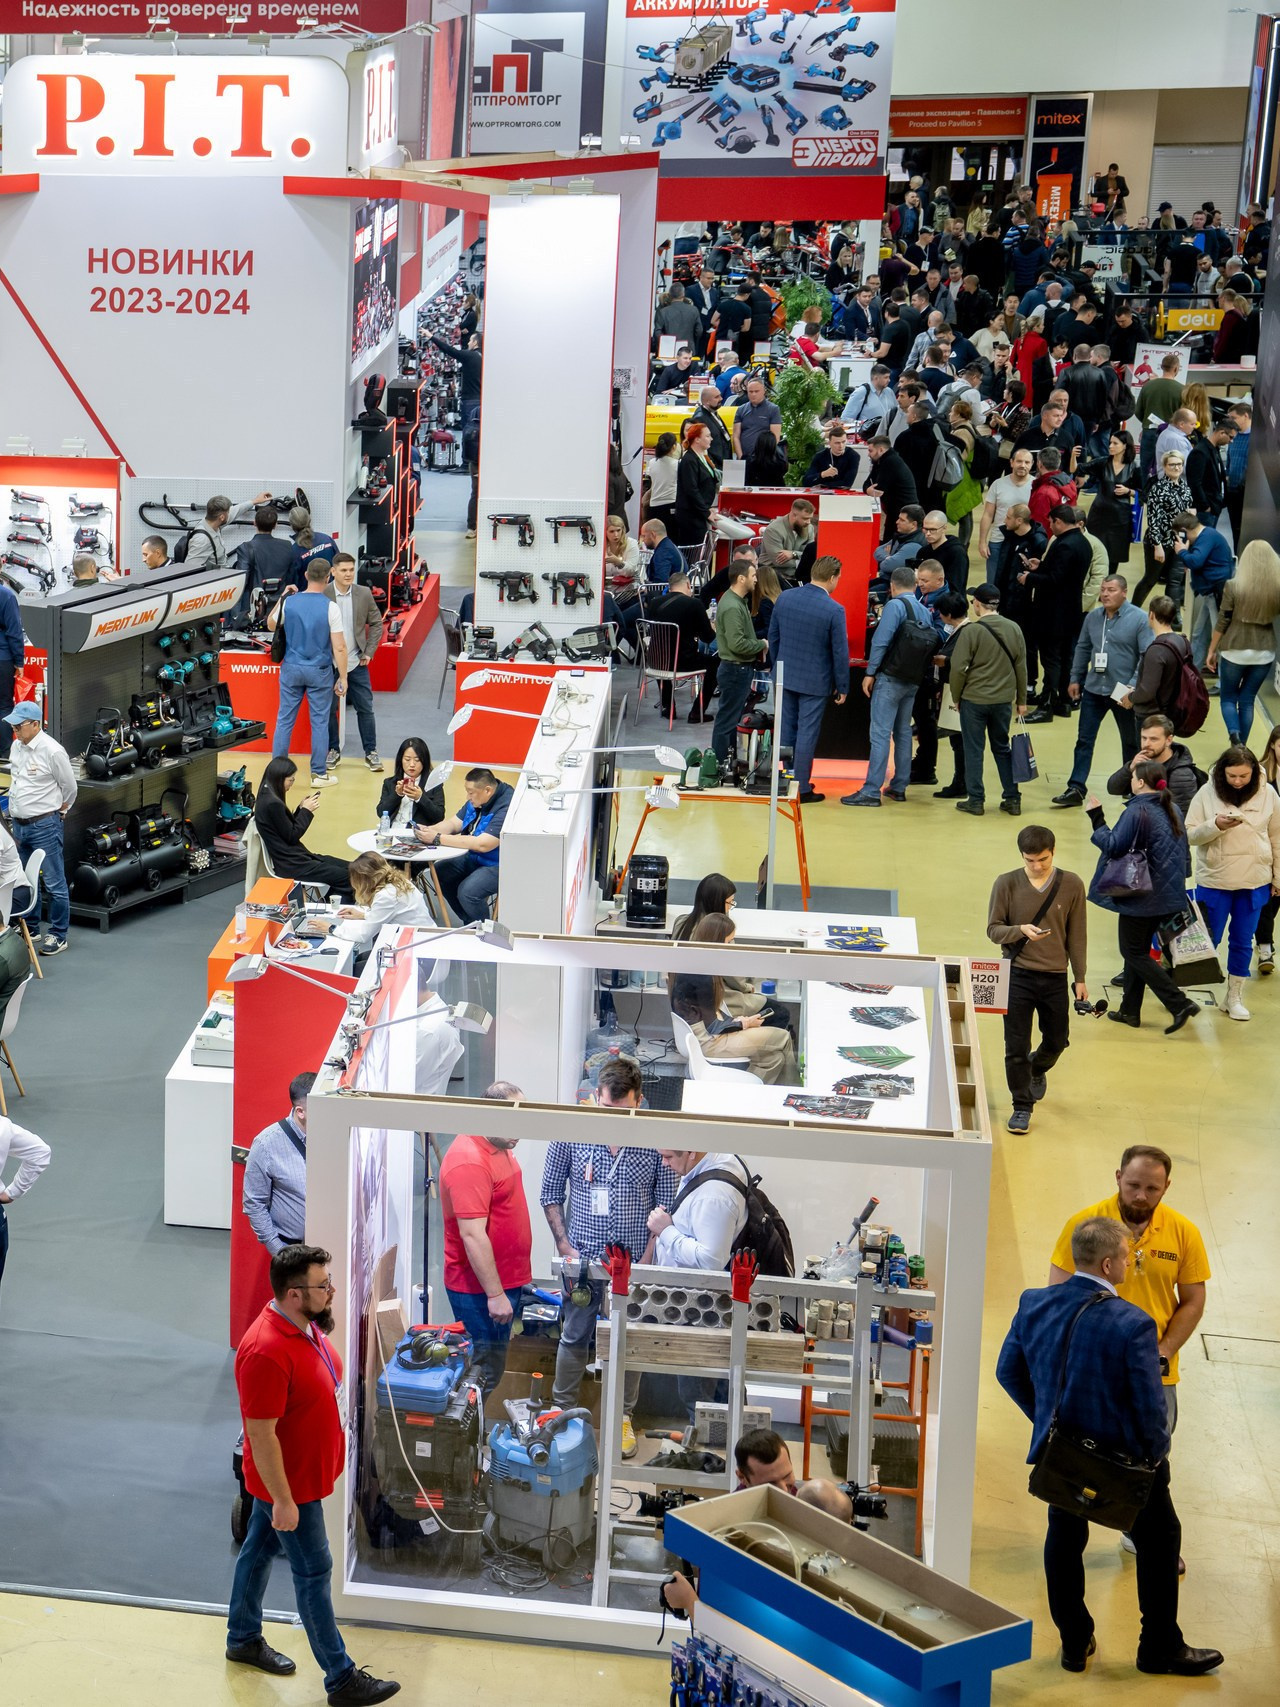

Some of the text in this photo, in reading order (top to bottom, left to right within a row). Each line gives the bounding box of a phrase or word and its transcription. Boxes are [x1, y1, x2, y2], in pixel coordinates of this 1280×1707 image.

[22, 2, 360, 22] Надежность проверена временем
[472, 95, 562, 107] ПТПРОМТОРГ
[36, 74, 311, 157] P.I.T.
[1037, 113, 1082, 125] mitex
[813, 152, 875, 167] ПРОМ
[88, 247, 254, 276] НОВИНКИ
[90, 288, 251, 316] 2023-2024
[1178, 314, 1215, 327] deli
[175, 587, 238, 616] MERIT LINK
[93, 608, 159, 638] MERIT LINK
[971, 974, 999, 983] H201
